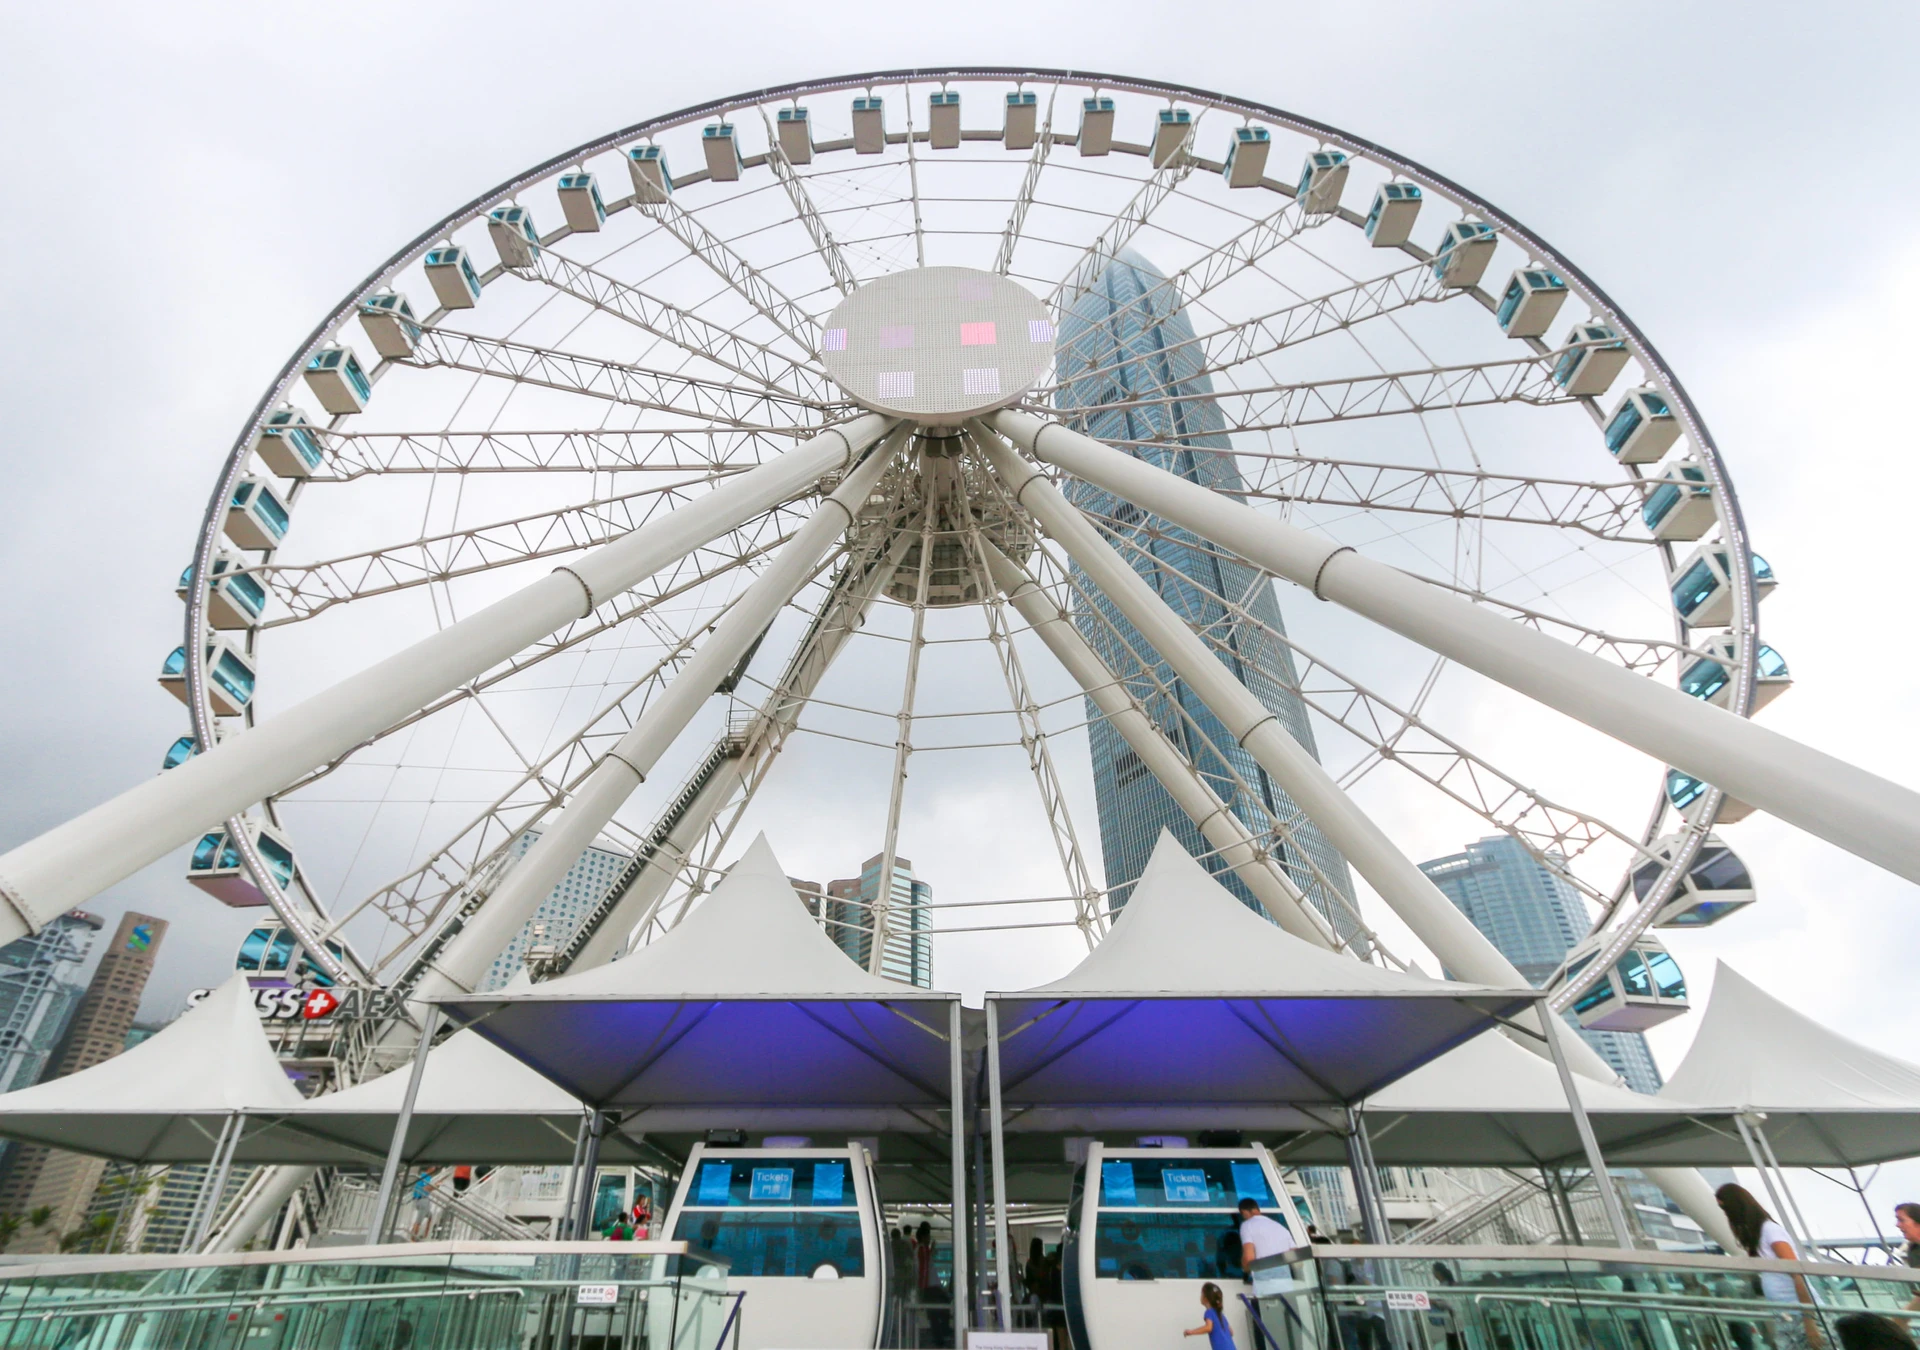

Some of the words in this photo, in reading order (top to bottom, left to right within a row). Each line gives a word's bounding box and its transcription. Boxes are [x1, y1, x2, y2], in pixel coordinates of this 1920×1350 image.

[331, 989, 415, 1018] AEX
[756, 1172, 789, 1182] Tickets
[1167, 1172, 1202, 1183] Tickets
